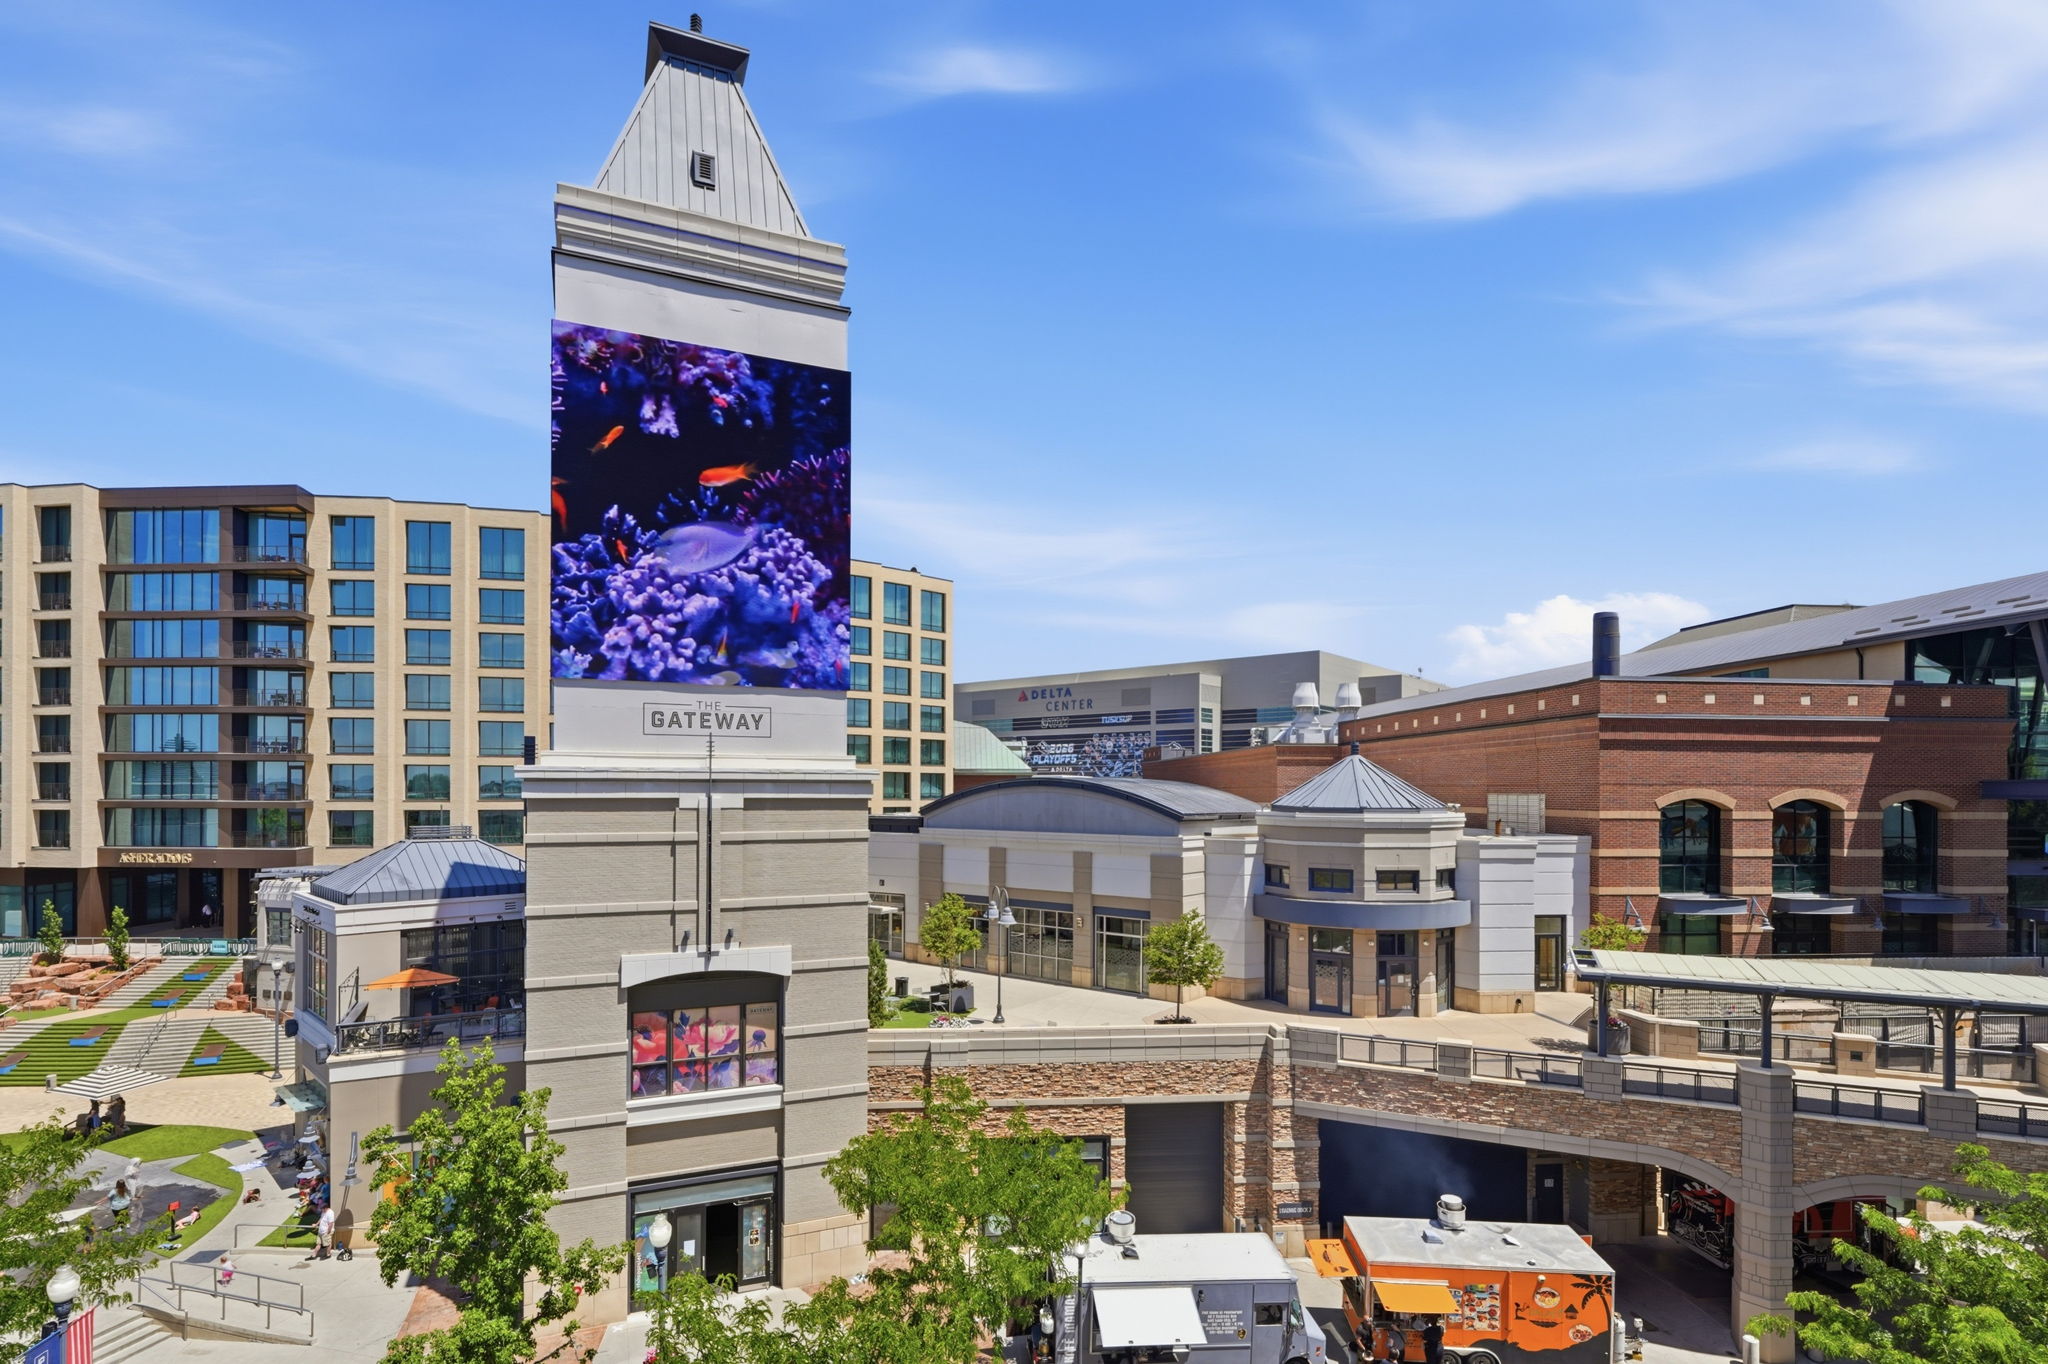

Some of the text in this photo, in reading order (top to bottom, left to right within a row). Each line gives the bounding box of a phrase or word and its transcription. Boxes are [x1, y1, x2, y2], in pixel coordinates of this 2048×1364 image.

[1031, 688, 1072, 699] DELTA
[696, 700, 722, 711] THE
[1046, 698, 1093, 711] CENTER
[651, 711, 763, 730] GATEWAY
[1050, 743, 1074, 753] 2026
[1032, 754, 1077, 764] PLAYOFFS
